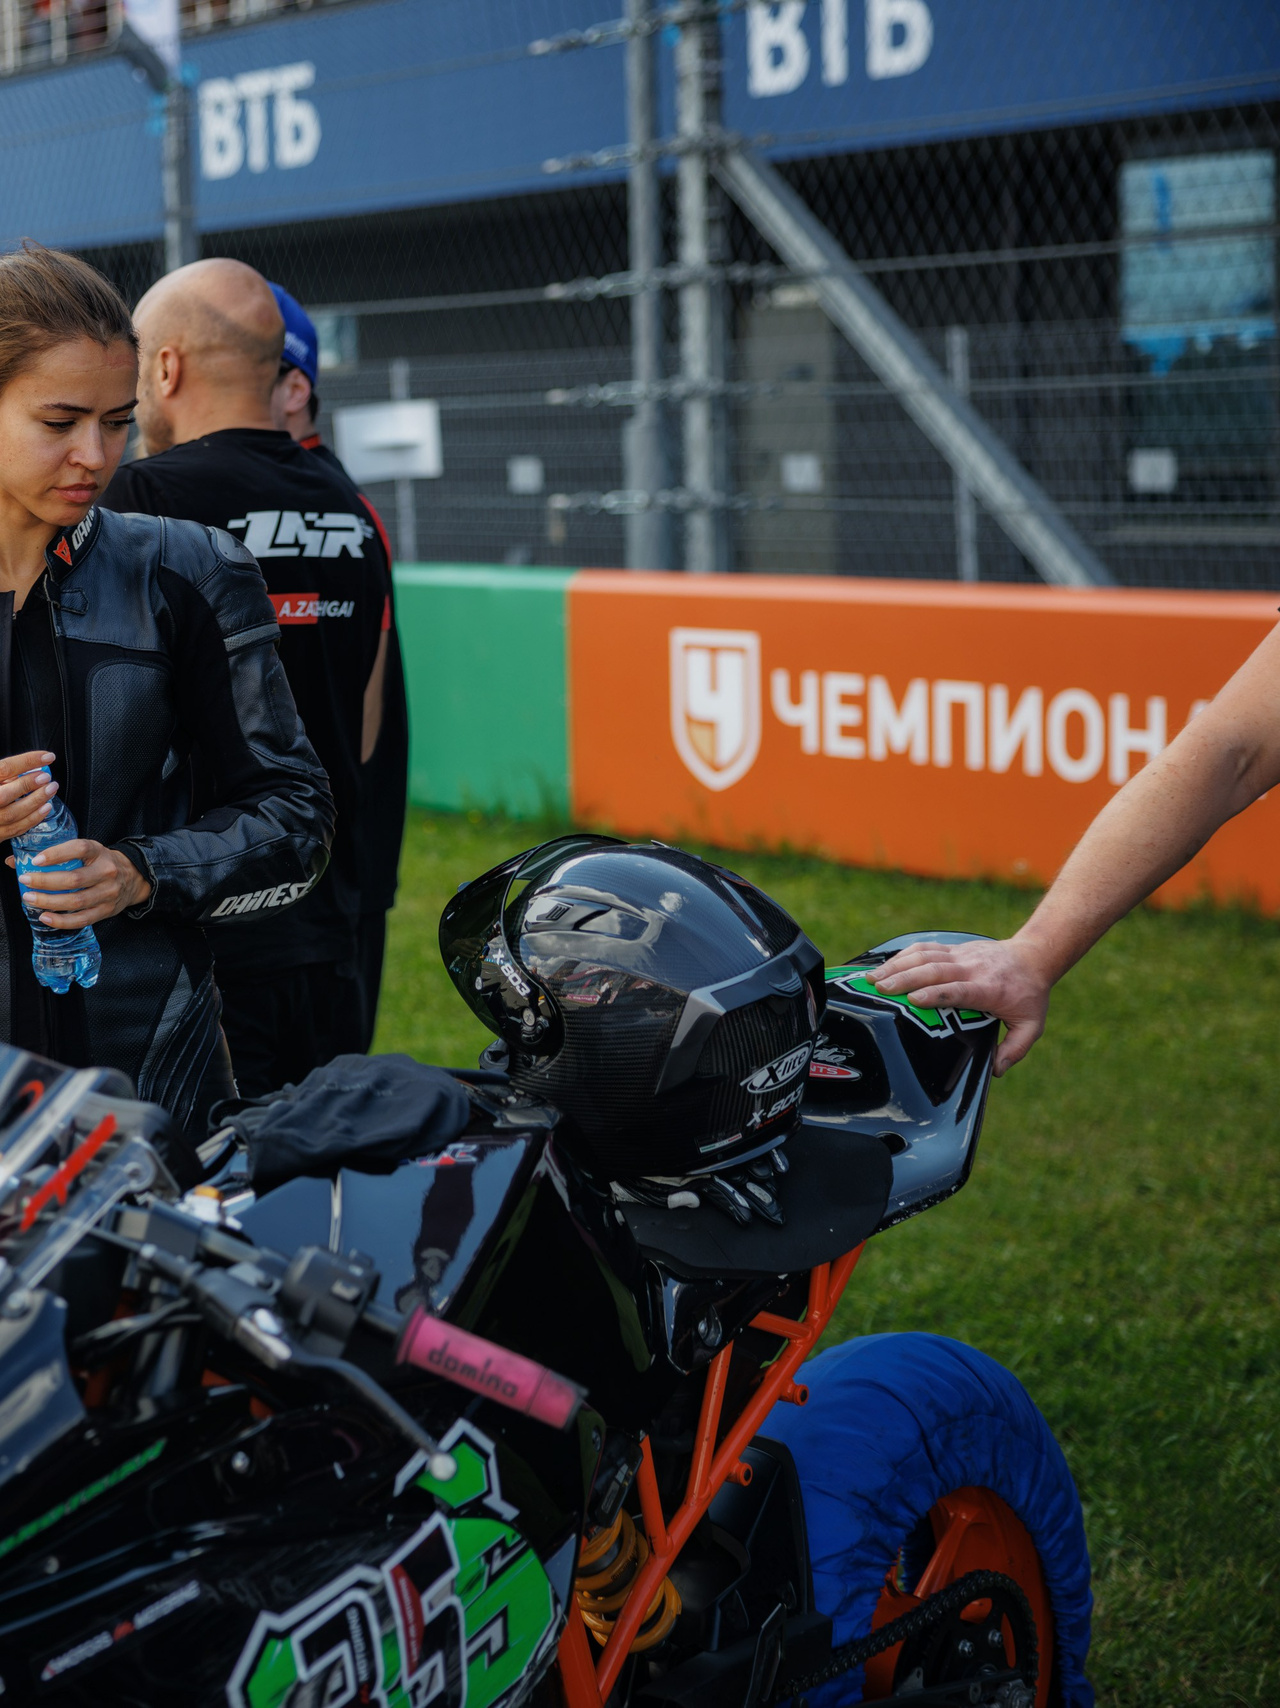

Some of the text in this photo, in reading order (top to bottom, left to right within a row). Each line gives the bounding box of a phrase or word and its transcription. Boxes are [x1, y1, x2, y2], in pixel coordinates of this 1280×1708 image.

[745, 0, 934, 99] ВТБ
[198, 60, 322, 181] ВТБ
[770, 667, 1214, 786] ЧЕМПИОН
[492, 948, 531, 997] X-803
[757, 1050, 808, 1091] X-lite
[427, 1338, 519, 1400] domino
